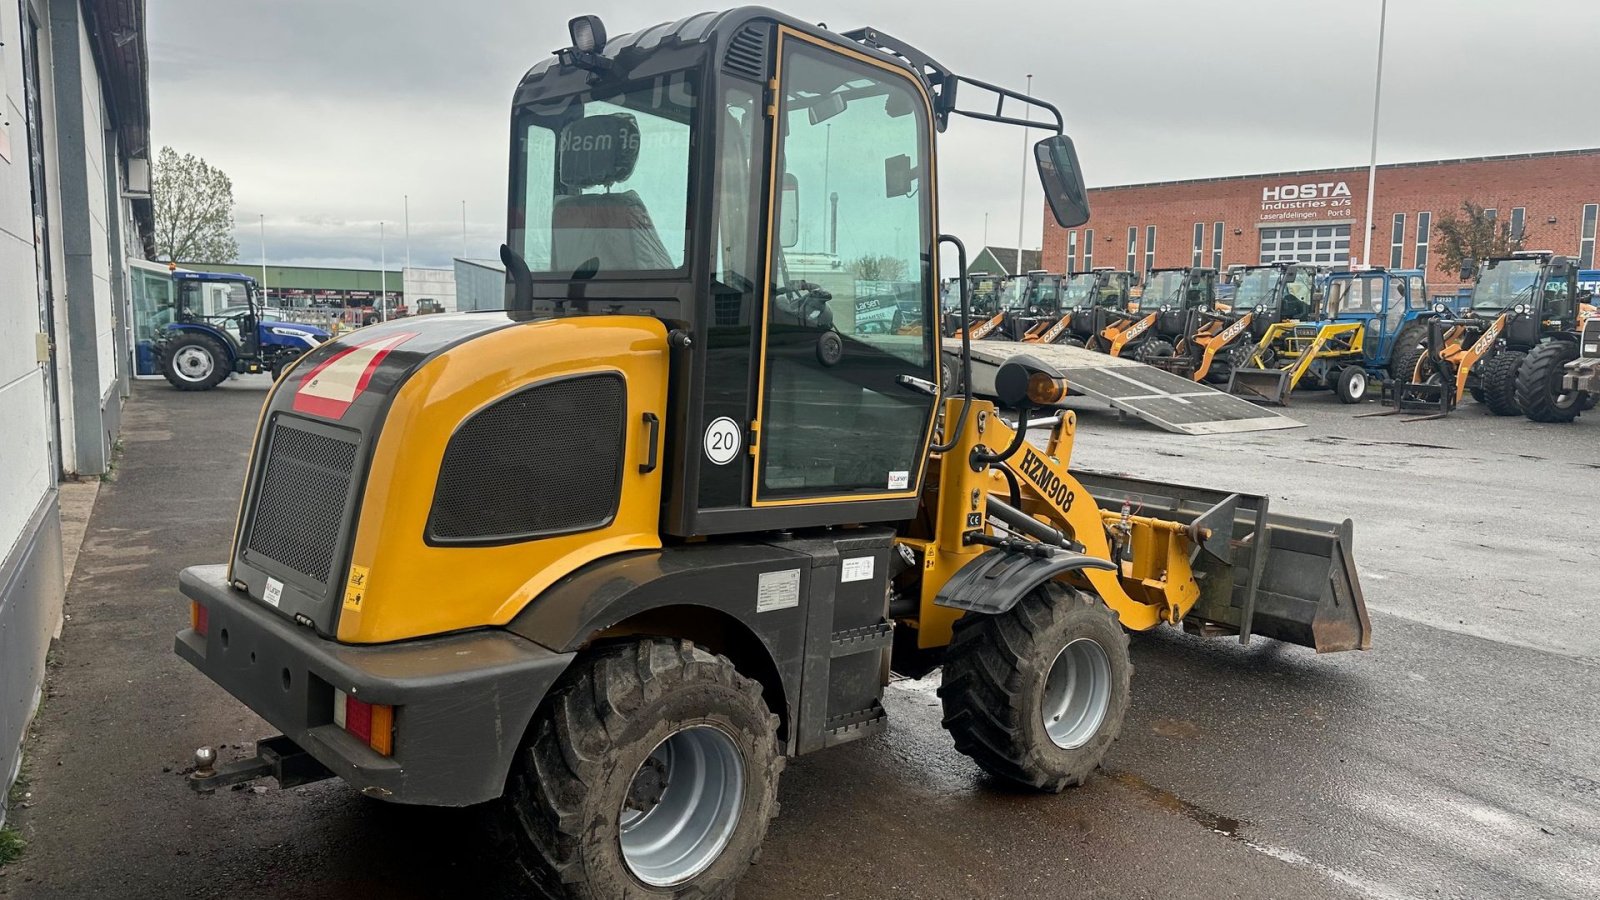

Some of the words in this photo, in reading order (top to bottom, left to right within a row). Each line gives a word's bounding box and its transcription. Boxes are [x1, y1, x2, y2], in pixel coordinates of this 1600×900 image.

[1263, 182, 1352, 201] HOSTA
[1261, 200, 1327, 210] industries
[1331, 199, 1351, 207] a/s
[1260, 211, 1317, 220] Laserafdelingen
[972, 320, 995, 339] CASE
[1043, 320, 1065, 343] CASE
[1125, 320, 1148, 340] CASE
[1221, 318, 1246, 341] CASE
[1474, 325, 1499, 354] CASE
[712, 432, 733, 450] 20
[1019, 448, 1075, 513] HZM908
[969, 515, 979, 525] CE
